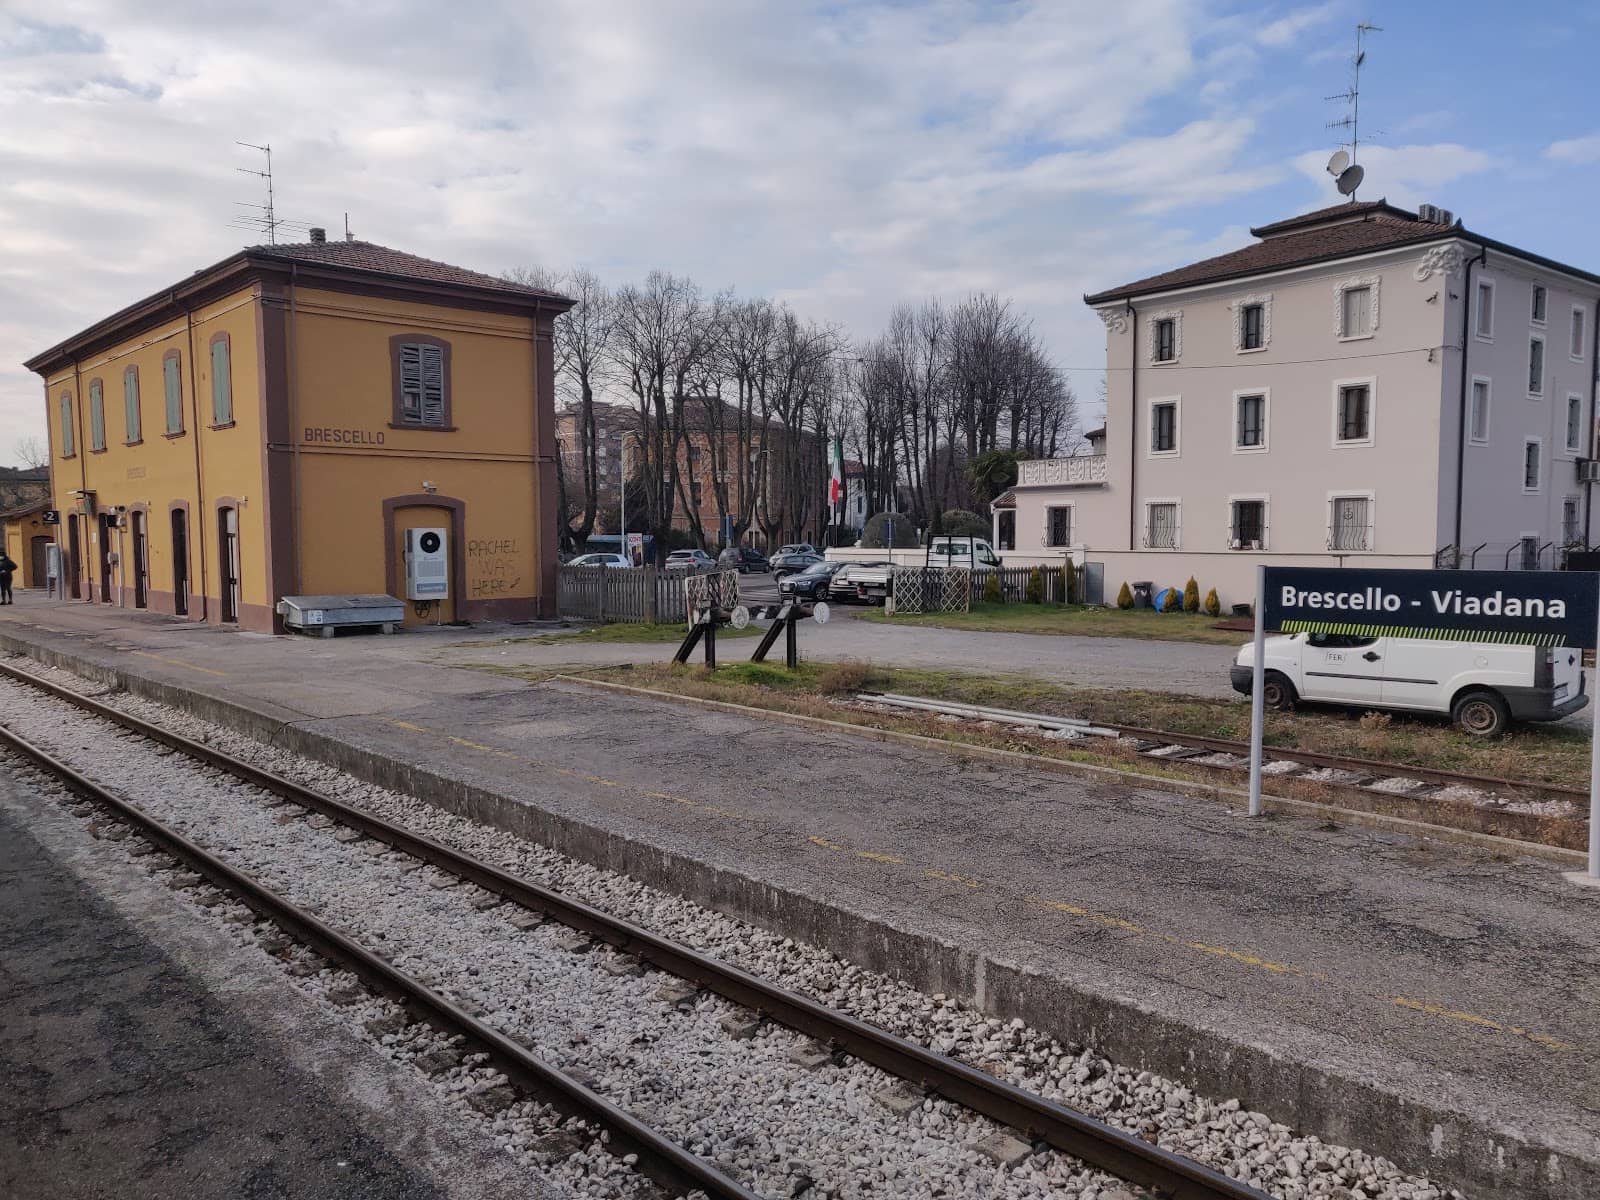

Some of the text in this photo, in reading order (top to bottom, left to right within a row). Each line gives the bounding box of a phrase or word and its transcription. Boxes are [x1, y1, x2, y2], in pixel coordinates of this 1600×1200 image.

[304, 427, 385, 445] BRESCELLO
[47, 511, 55, 521] 2
[468, 539, 520, 557] RACHEL
[471, 578, 509, 597] HERE
[1281, 585, 1401, 612] Brescello
[1431, 590, 1566, 618] Viadana
[1328, 653, 1344, 662] FER
